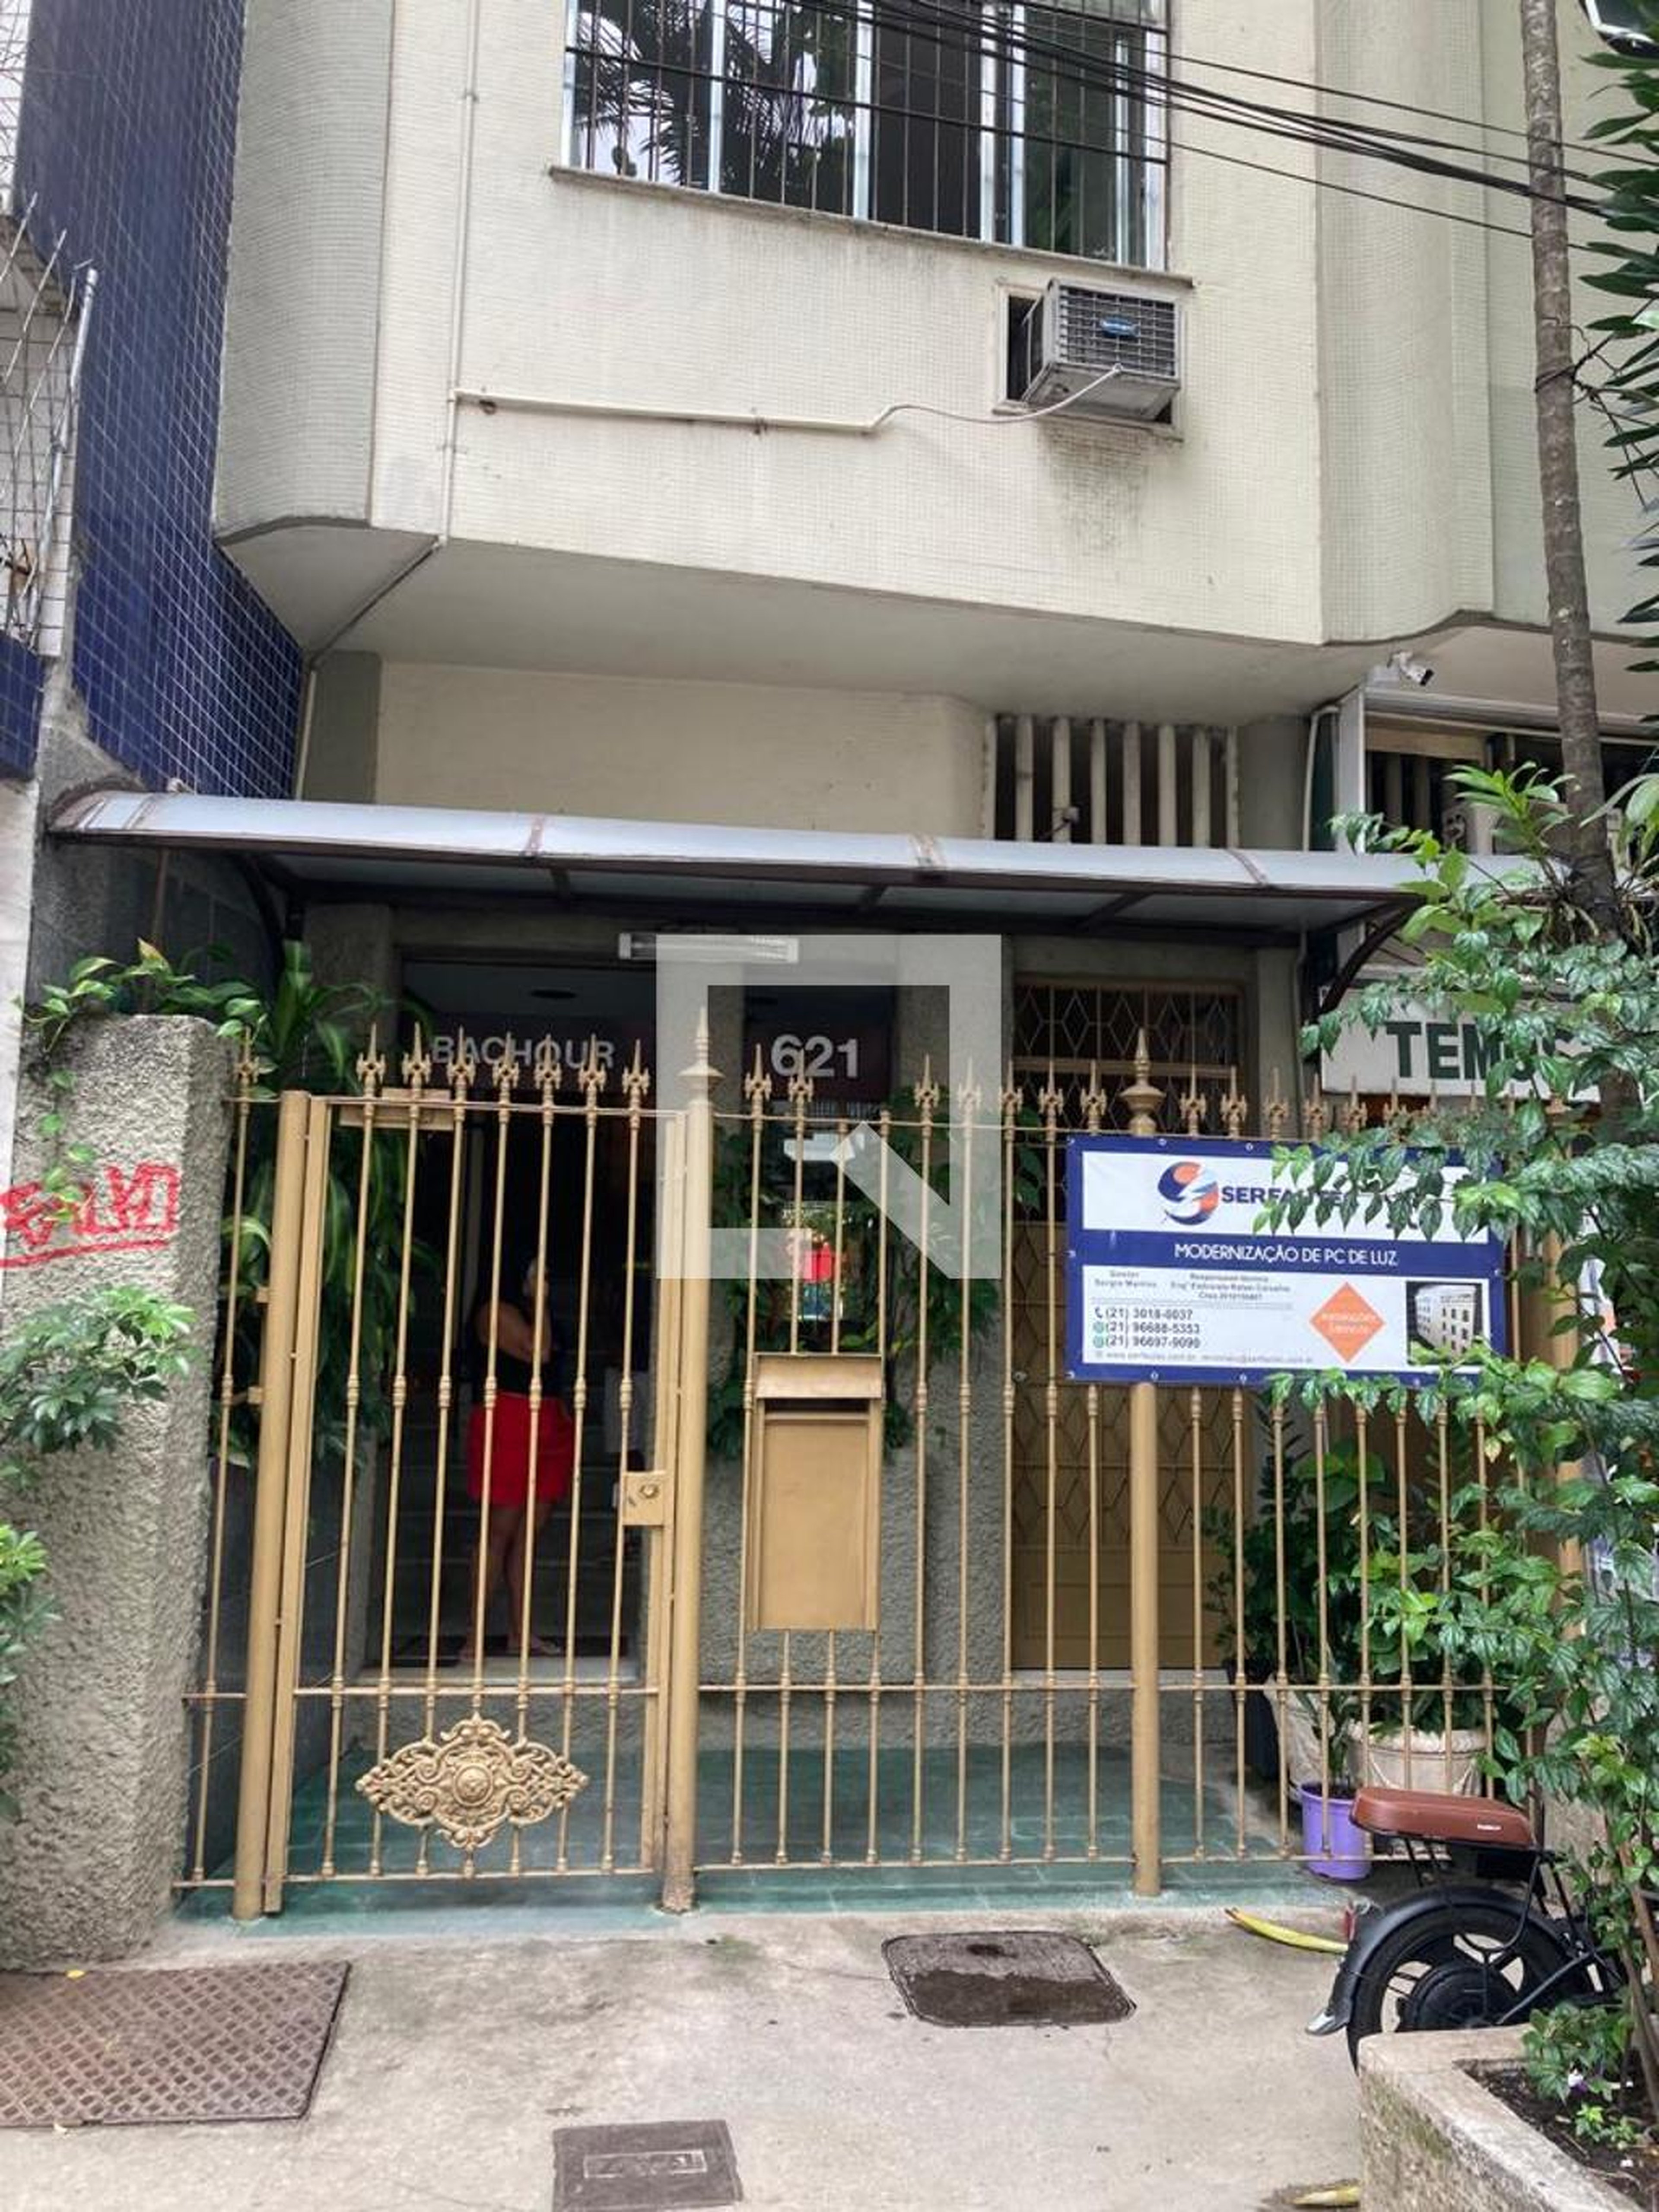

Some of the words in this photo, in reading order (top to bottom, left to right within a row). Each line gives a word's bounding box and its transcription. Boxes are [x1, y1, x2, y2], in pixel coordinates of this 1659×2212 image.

[432, 1036, 615, 1069] BACHOUR
[771, 1034, 858, 1077] 621
[1174, 1244, 1299, 1263] MODERNIZAÇÃO
[1302, 1248, 1321, 1263] DE
[1324, 1249, 1345, 1264] PC
[1348, 1250, 1367, 1264] DE
[1371, 1251, 1398, 1266] LUZ
[1106, 1308, 1128, 1321] (21)
[1106, 1321, 1128, 1335] (21)
[1106, 1334, 1128, 1349] (21)
